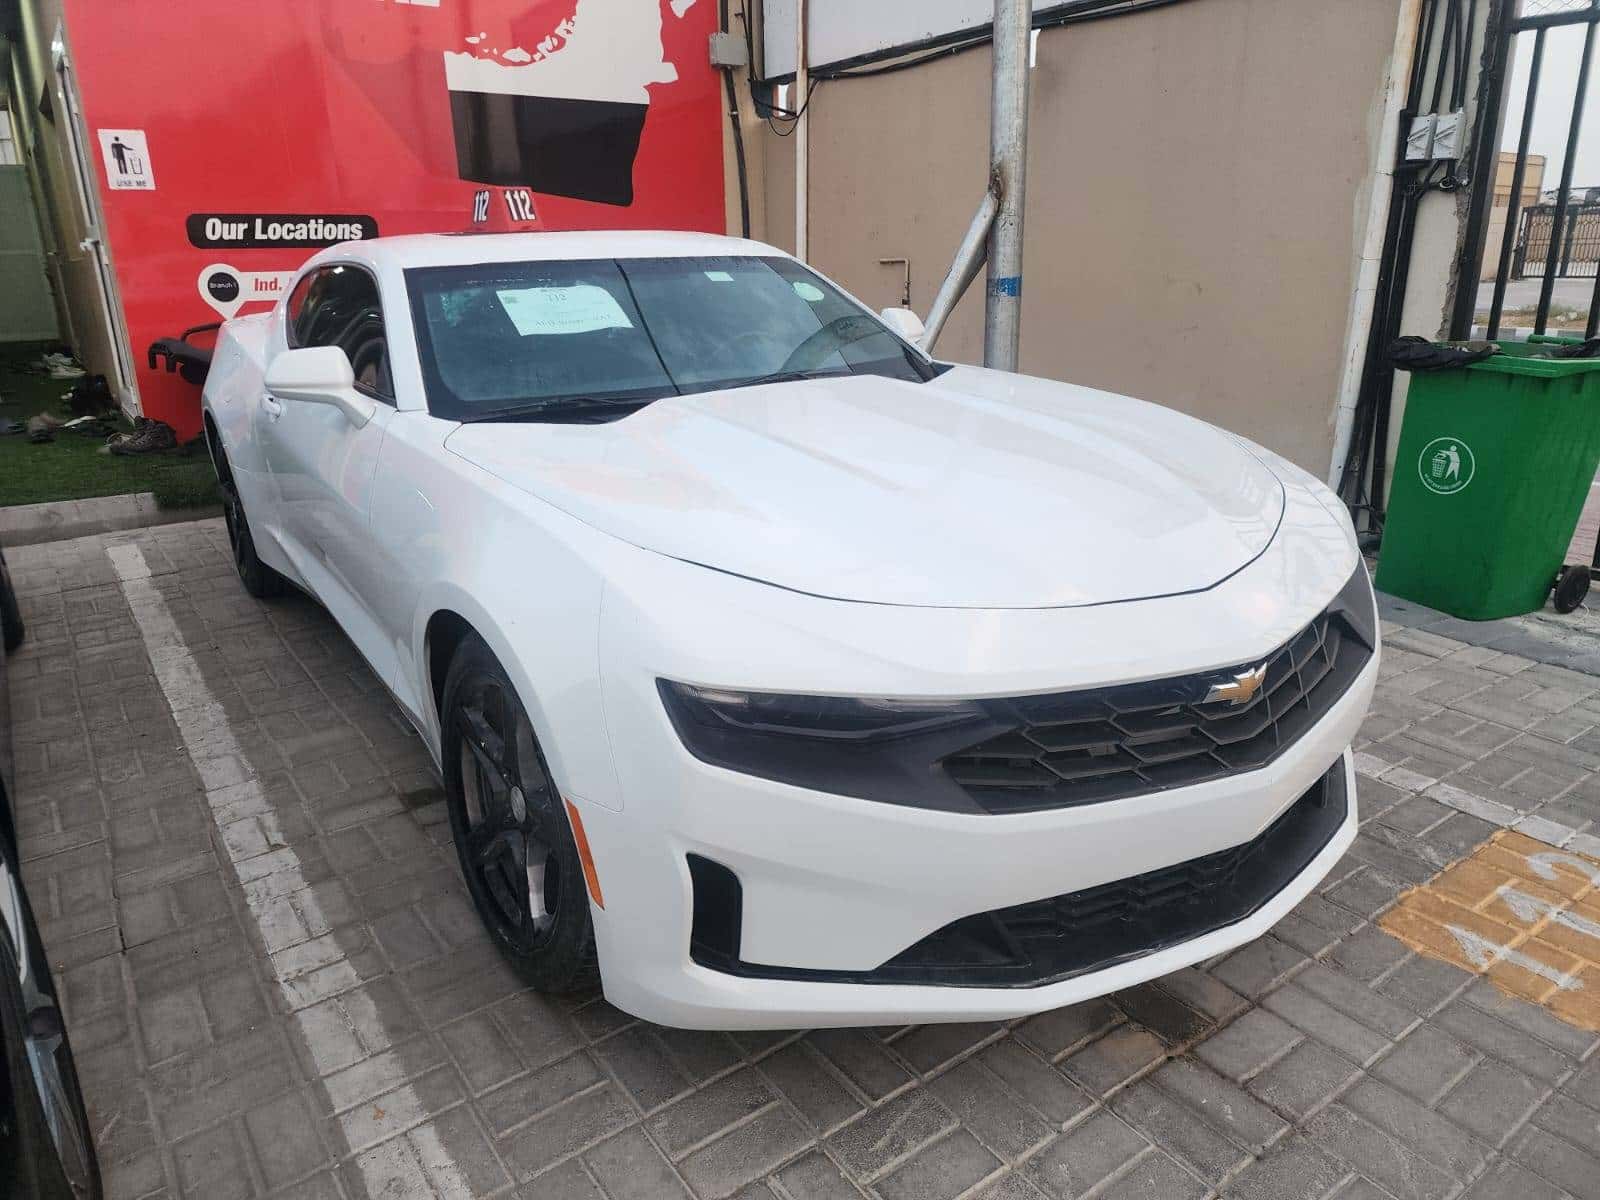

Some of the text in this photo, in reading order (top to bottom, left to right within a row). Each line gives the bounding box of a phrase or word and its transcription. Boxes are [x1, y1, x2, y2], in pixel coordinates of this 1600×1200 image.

[473, 190, 490, 223] 112
[504, 190, 536, 221] 112
[205, 217, 363, 241] Our Locations
[254, 277, 283, 291] Ind.
